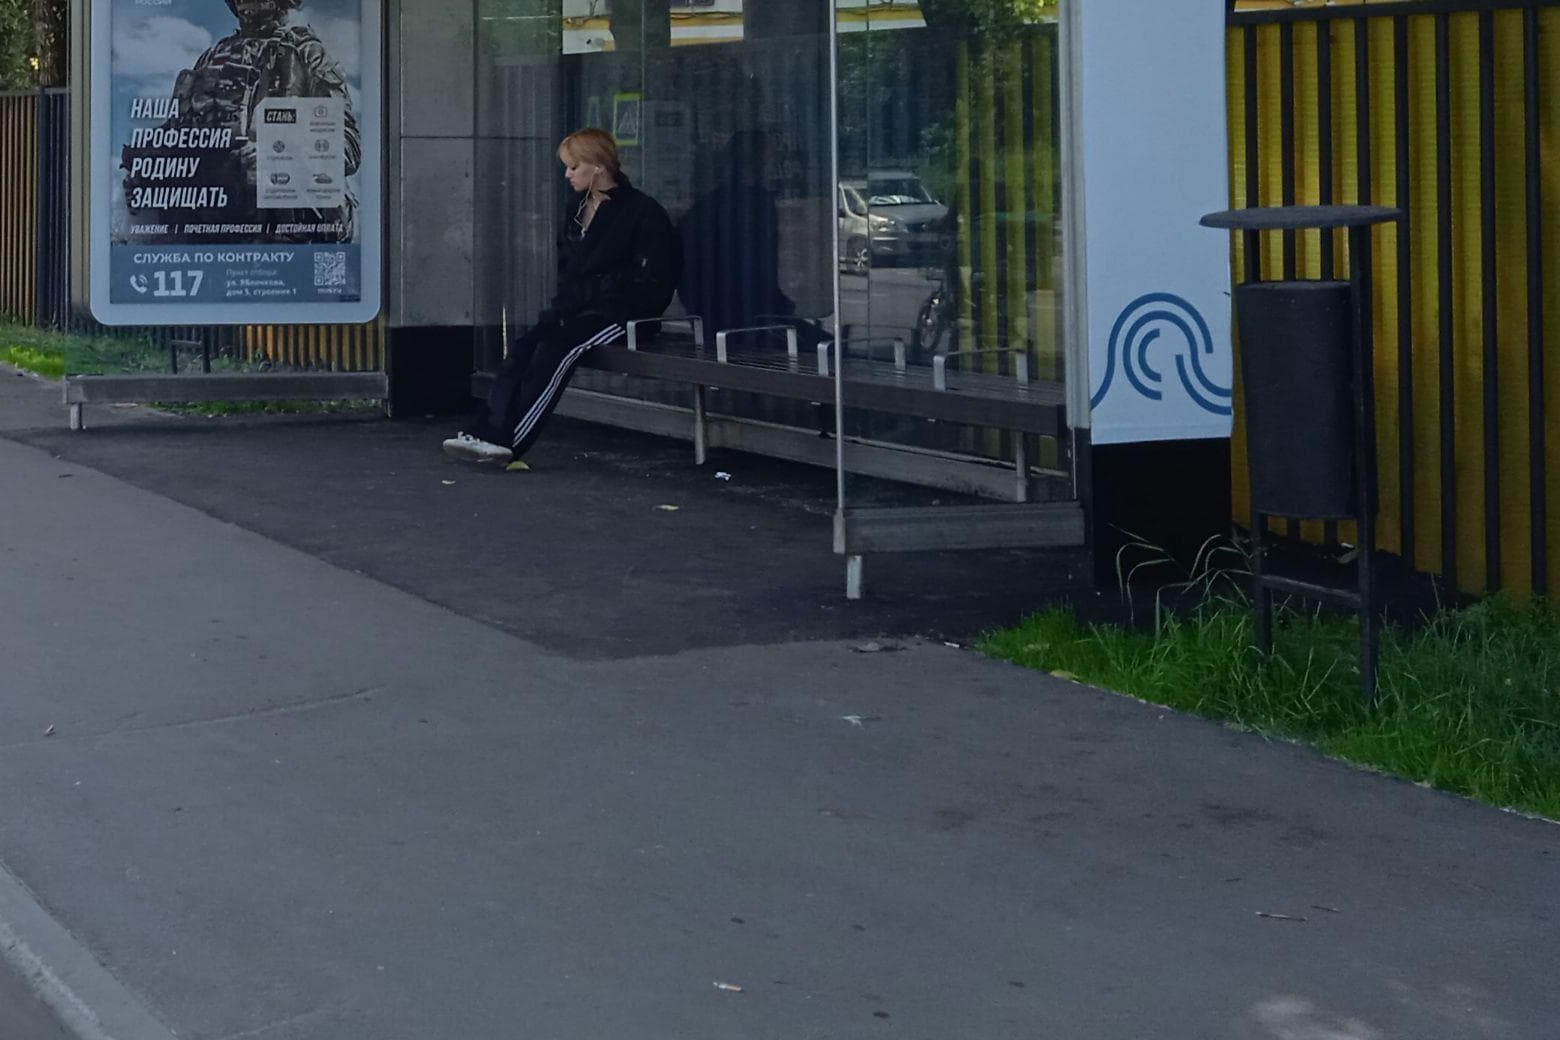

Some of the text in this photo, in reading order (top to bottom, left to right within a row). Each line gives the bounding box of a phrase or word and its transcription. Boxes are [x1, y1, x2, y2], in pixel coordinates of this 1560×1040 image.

[131, 98, 180, 119] НАША
[130, 127, 232, 149] ПРОФЕССИЯ
[131, 157, 200, 180] РОДИНУ
[131, 187, 228, 209] ЗАЩИЩАТЬ
[220, 224, 262, 233] ПРОФЕССИЯ
[133, 251, 295, 264] СЛУЖБА ПО КОНТРАКТУ
[153, 270, 204, 297] 117
